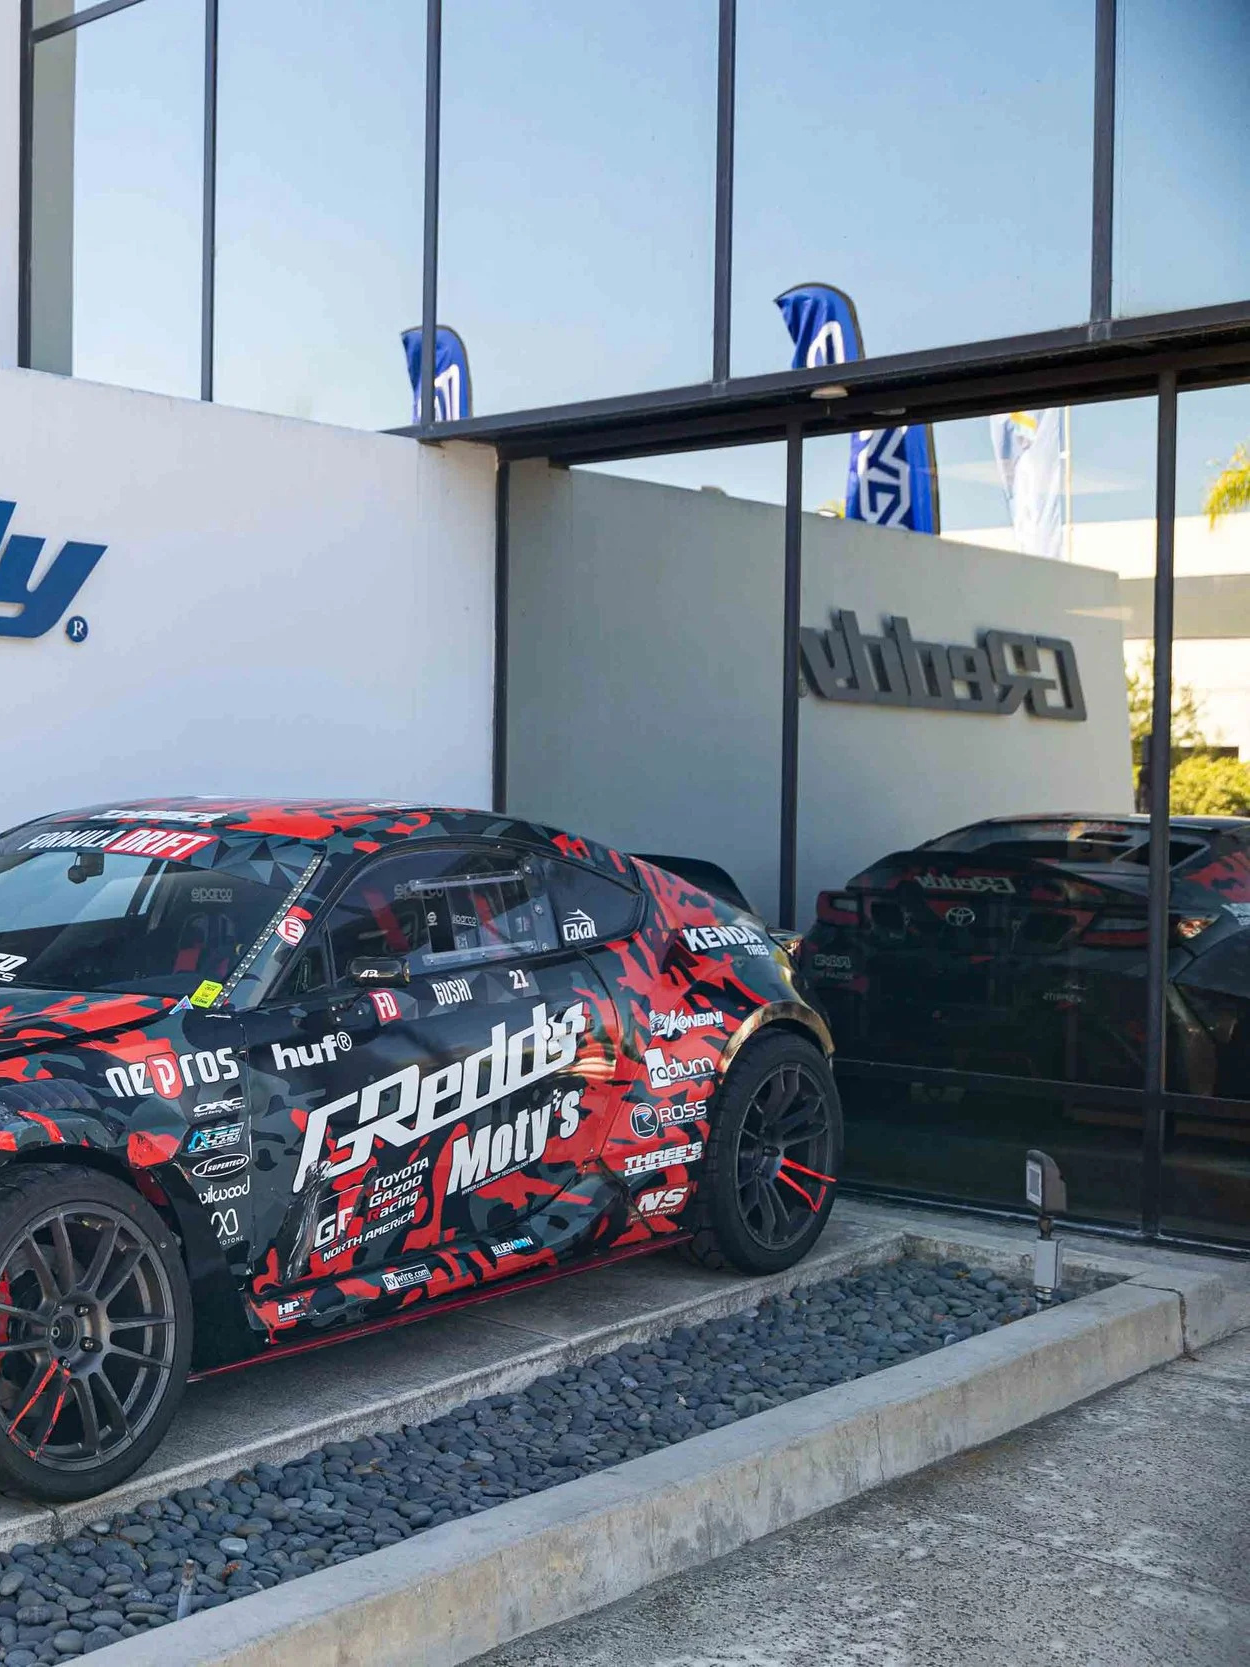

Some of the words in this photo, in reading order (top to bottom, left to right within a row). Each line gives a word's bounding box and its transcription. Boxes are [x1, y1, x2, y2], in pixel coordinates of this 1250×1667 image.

[16, 829, 127, 850] FORMULA
[109, 829, 211, 857] DRIFT
[285, 920, 299, 940] E
[682, 925, 763, 952] KENDA
[744, 944, 769, 956] TIRES
[431, 978, 474, 1006] GUSHI
[508, 968, 530, 990] 21
[372, 991, 398, 1019] FD
[105, 1047, 240, 1098] nepros
[650, 1056, 715, 1083] radium
[292, 1002, 587, 1194] GReddy
[659, 1100, 707, 1122] ROSS
[207, 1157, 246, 1172] SUPERTECH
[625, 1141, 703, 1169] THREE'S
[374, 1157, 429, 1192] TOYOTA
[369, 1174, 423, 1208] GAZOO
[638, 1187, 688, 1213] NS
[366, 1190, 419, 1222] Racing
[323, 1235, 363, 1262] NORTH
